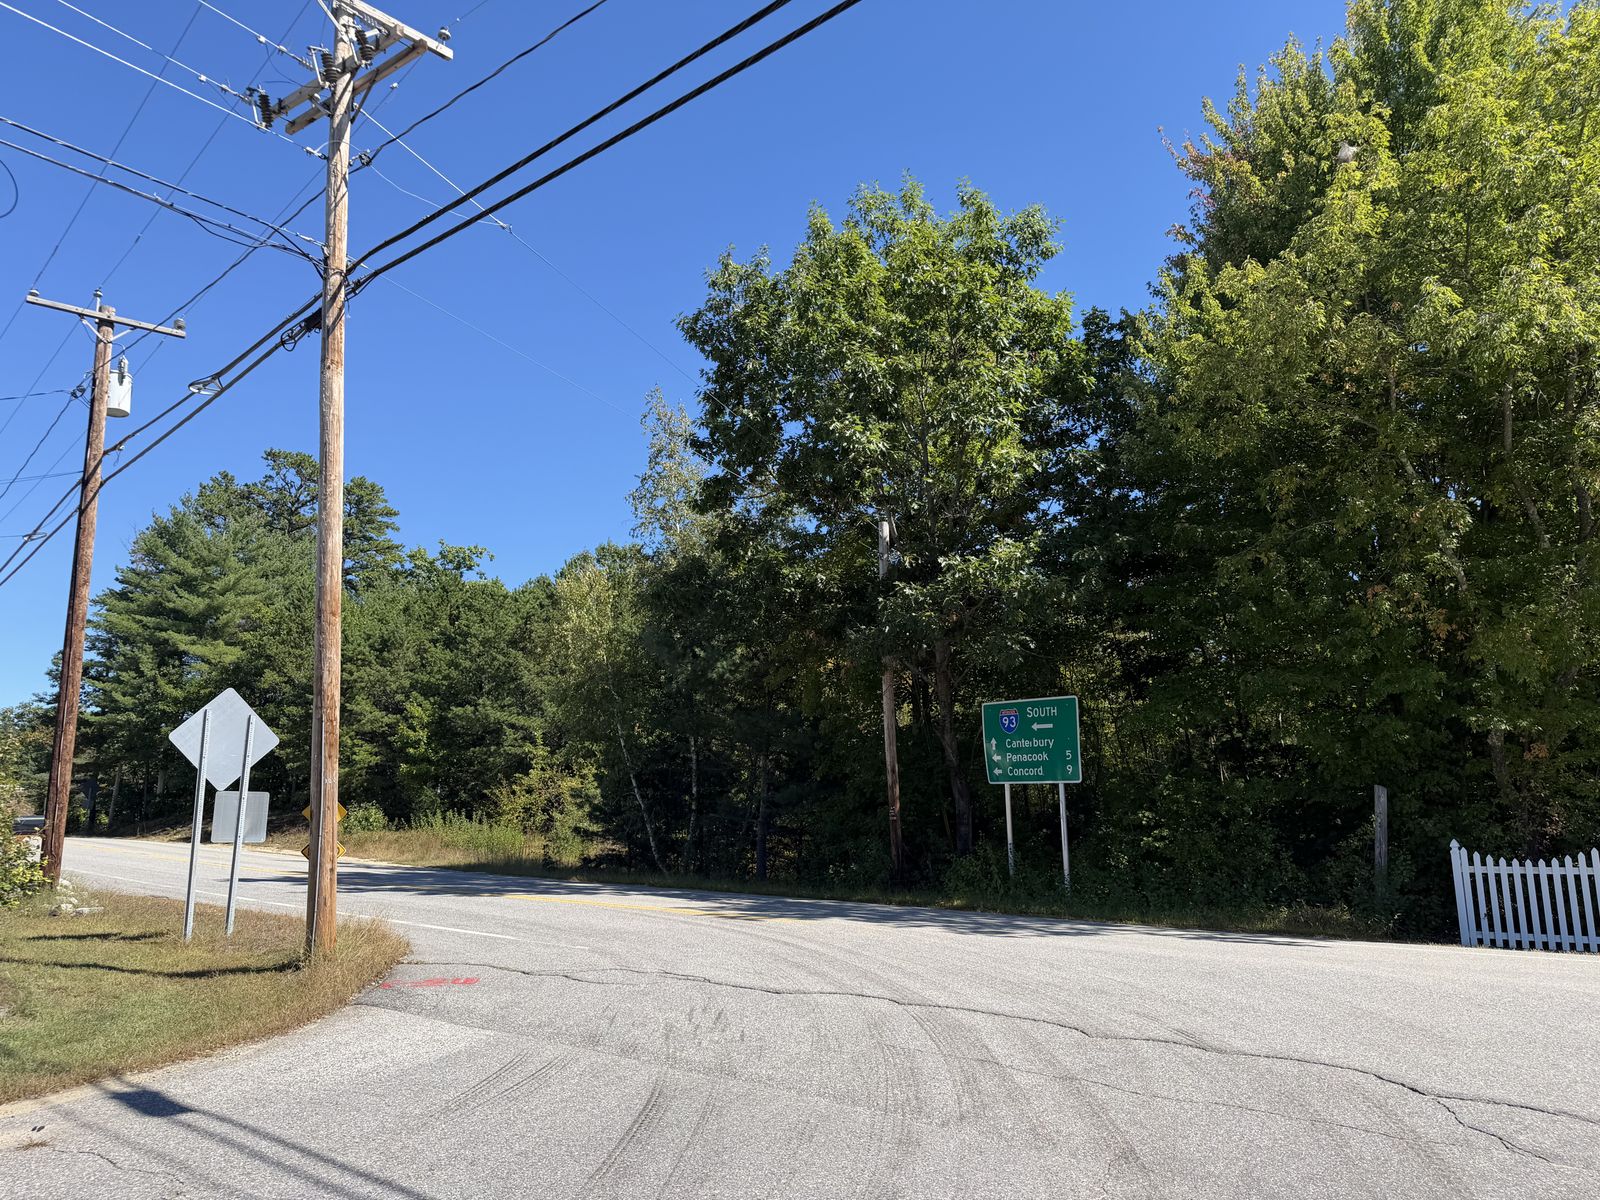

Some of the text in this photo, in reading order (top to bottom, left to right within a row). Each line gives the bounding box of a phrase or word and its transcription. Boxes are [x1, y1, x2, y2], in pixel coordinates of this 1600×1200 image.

[1026, 706, 1057, 717] SOUTH
[1002, 716, 1016, 728] 93
[1006, 750, 1072, 762] Penacook 5
[1007, 764, 1073, 776] Concord 9
